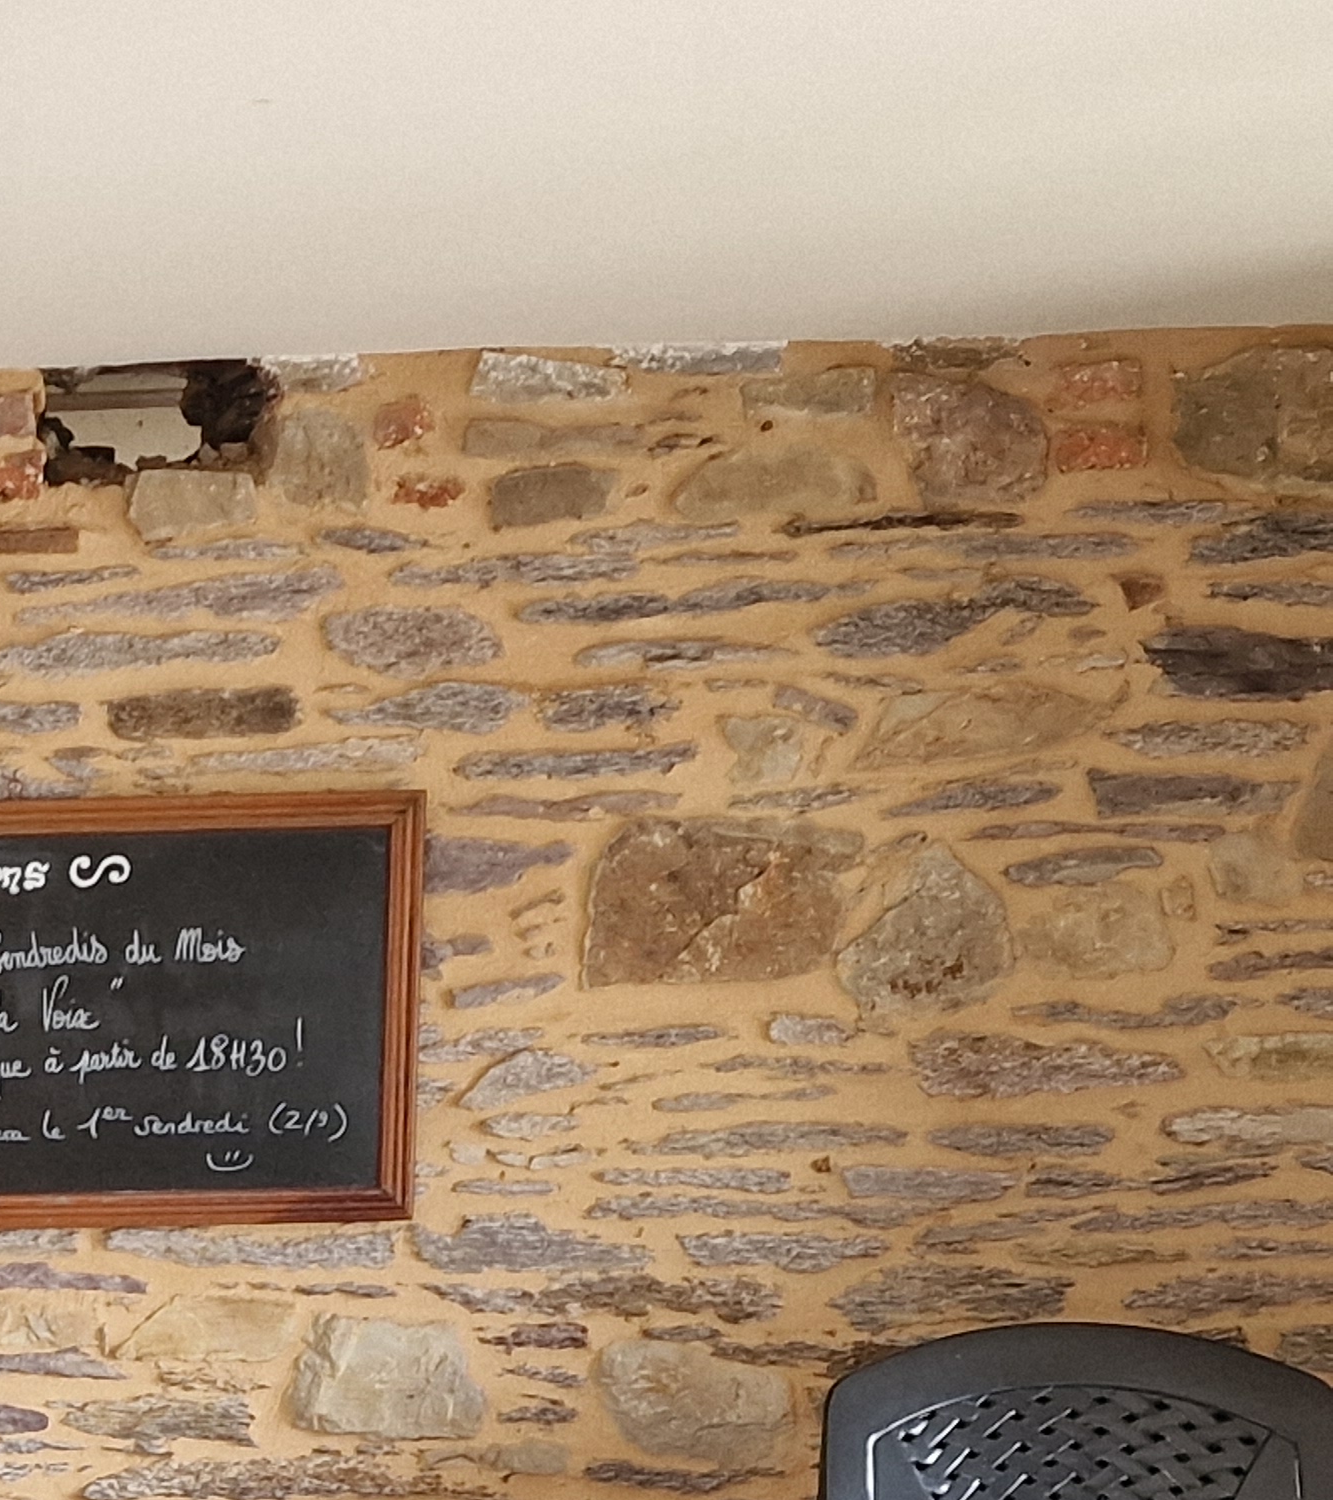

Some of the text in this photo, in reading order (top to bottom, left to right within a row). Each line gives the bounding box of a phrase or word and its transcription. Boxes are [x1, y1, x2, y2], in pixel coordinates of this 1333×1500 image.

[124, 928, 162, 966] du
[44, 1047, 65, 1074] à
[68, 1038, 143, 1085] partir
[150, 1034, 178, 1072] de
[42, 1109, 67, 1139] le
[76, 1105, 134, 1140] 1er
[268, 1102, 348, 1143] (2/9)
